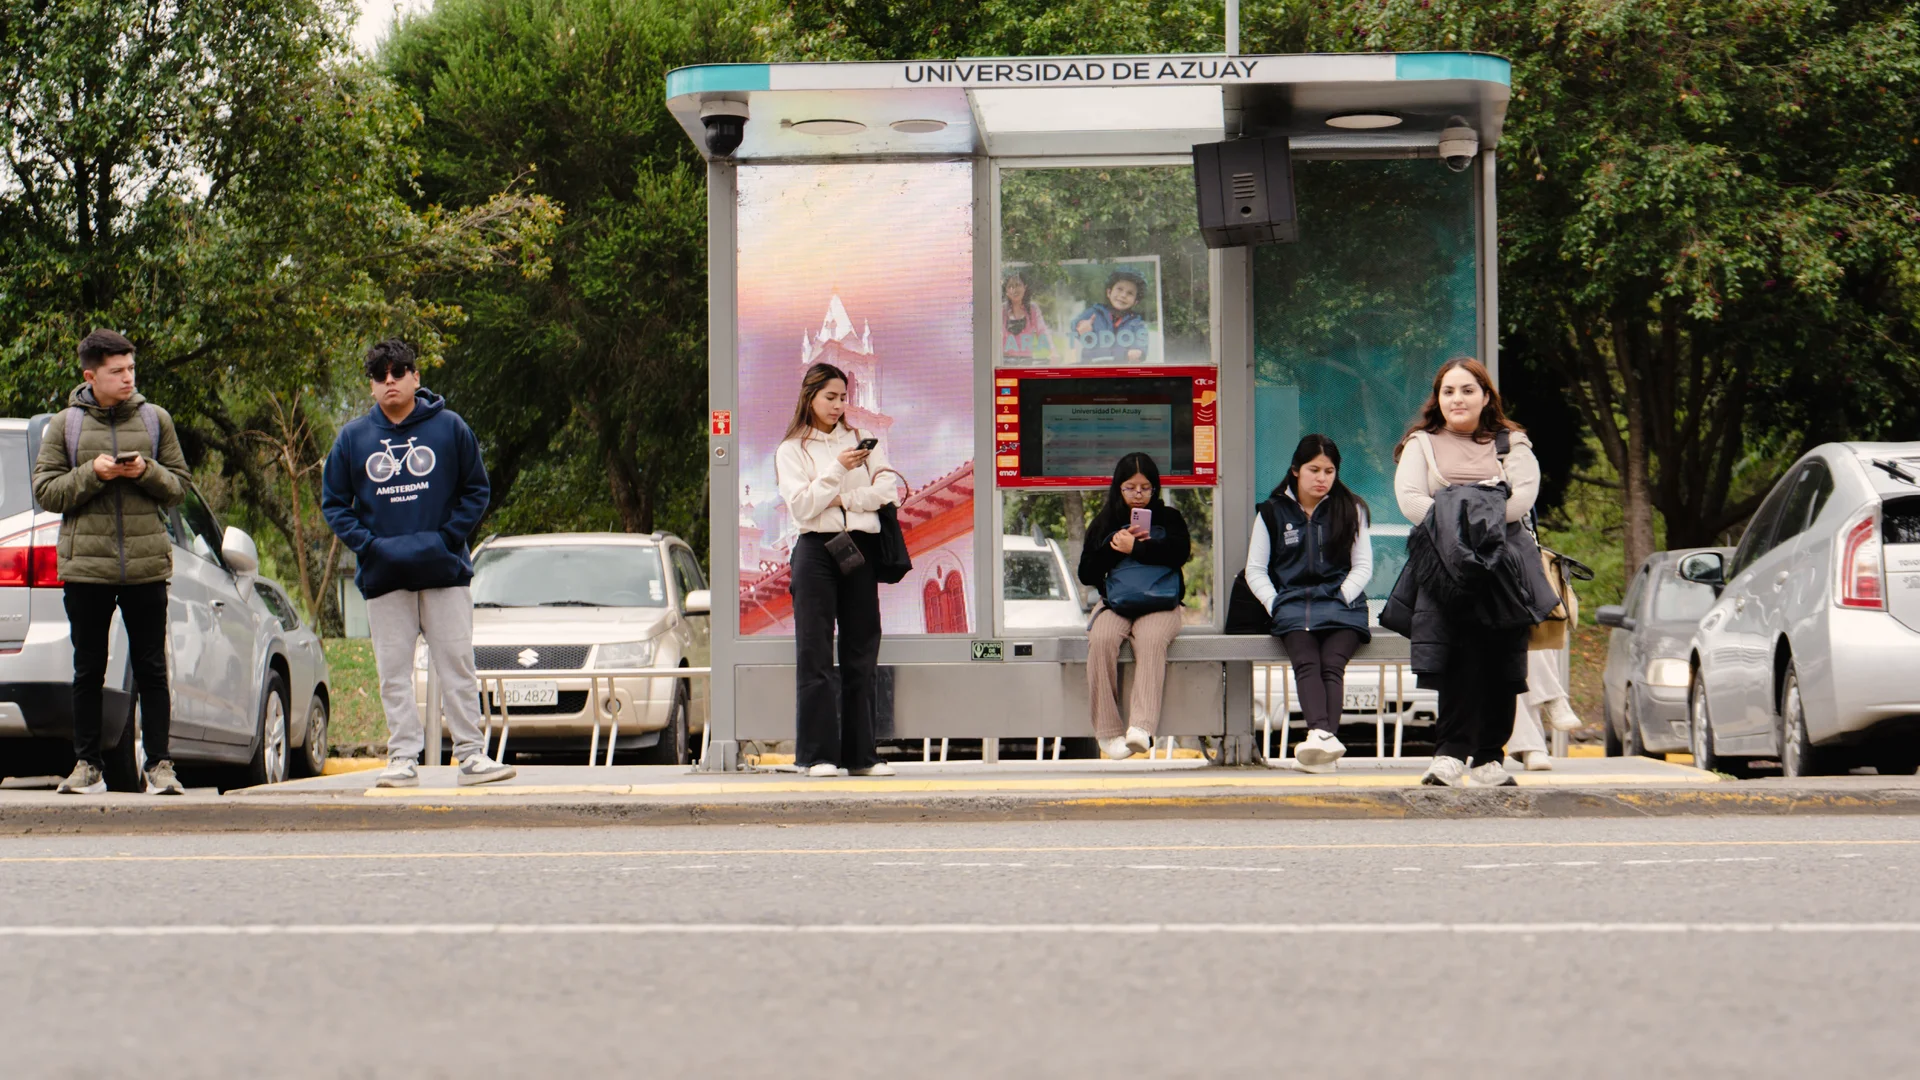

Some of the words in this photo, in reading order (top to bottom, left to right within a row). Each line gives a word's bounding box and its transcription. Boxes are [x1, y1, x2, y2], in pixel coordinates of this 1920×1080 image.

[904, 62, 1105, 83] UNIVERSIDAD
[1113, 62, 1150, 80] DE
[1157, 60, 1259, 80] AZUAY
[1004, 333, 1051, 352] ARA
[1067, 328, 1149, 350] TODOS
[1071, 407, 1110, 415] Universidad
[1110, 407, 1121, 415] Del
[1121, 407, 1142, 416] Azuay
[376, 481, 430, 496] AMSTERDAM
[390, 494, 419, 503] HOLLAND
